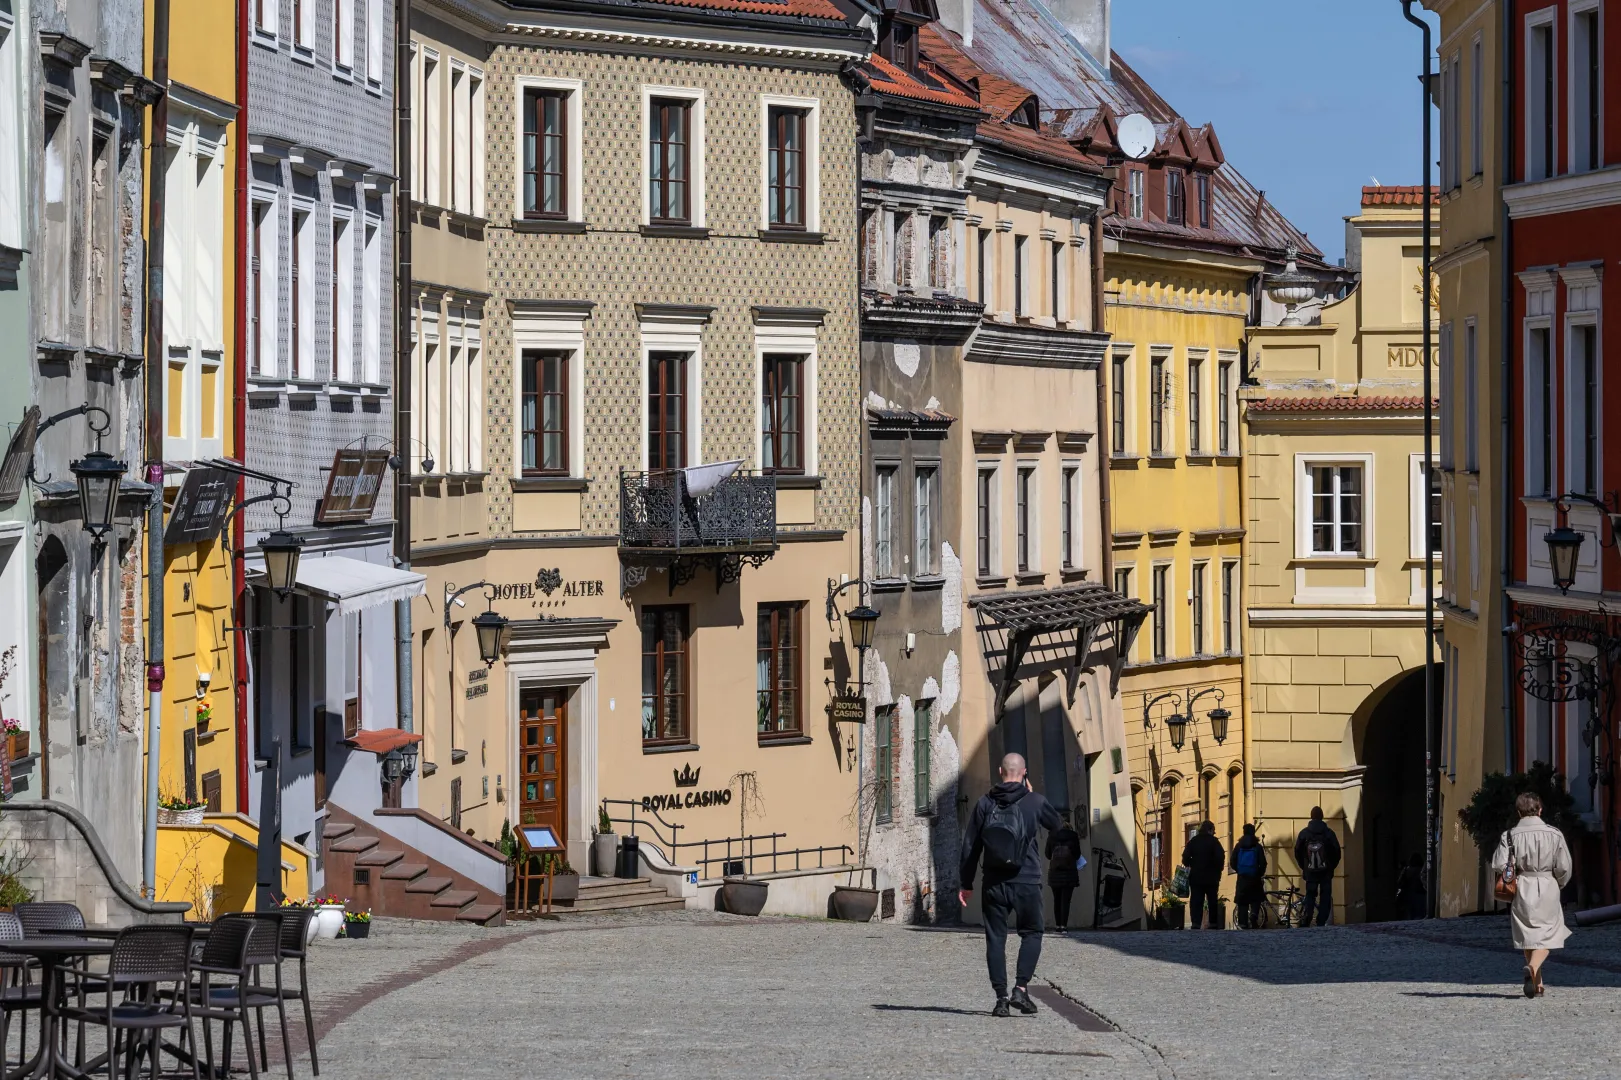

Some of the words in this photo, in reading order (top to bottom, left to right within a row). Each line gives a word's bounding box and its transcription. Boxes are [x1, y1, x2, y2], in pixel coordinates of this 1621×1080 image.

[493, 582, 535, 601] HOTEL
[562, 580, 604, 597] ALTER
[1517, 666, 1586, 702] GRODZ
[833, 710, 864, 718] CASINO
[836, 702, 862, 710] ROYAL
[641, 793, 683, 813] ROYAL
[684, 788, 732, 809] CASINO
